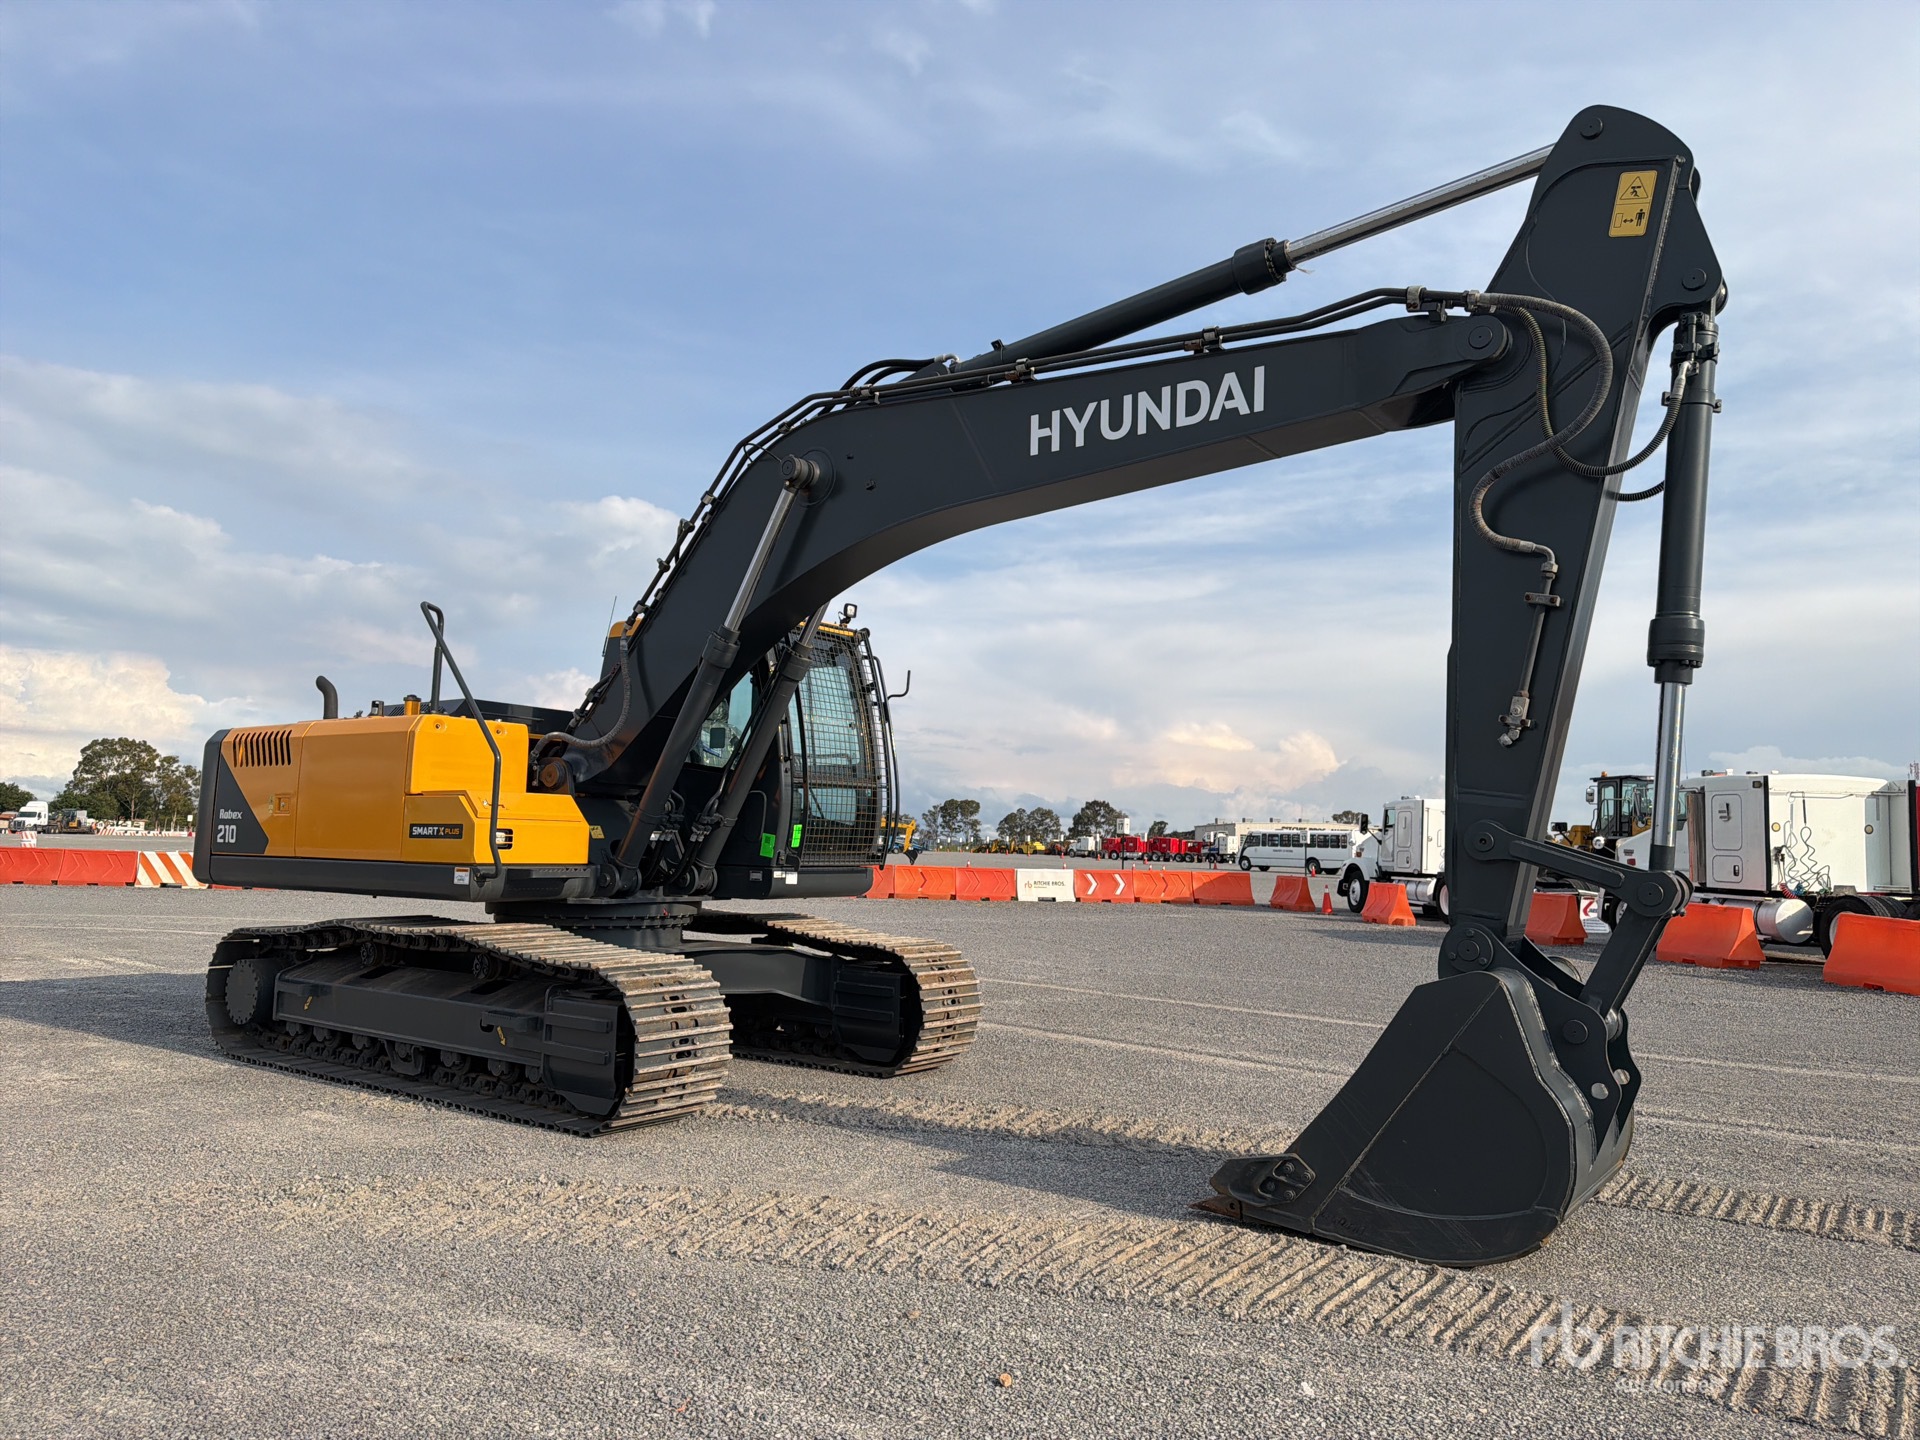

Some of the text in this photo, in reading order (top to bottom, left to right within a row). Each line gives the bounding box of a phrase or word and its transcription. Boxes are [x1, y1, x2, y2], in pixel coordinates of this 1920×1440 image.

[1029, 365, 1265, 456] HYUNDAI
[219, 808, 243, 820] Robex
[216, 824, 237, 843] 210
[412, 826, 460, 836] SMART X PLUS
